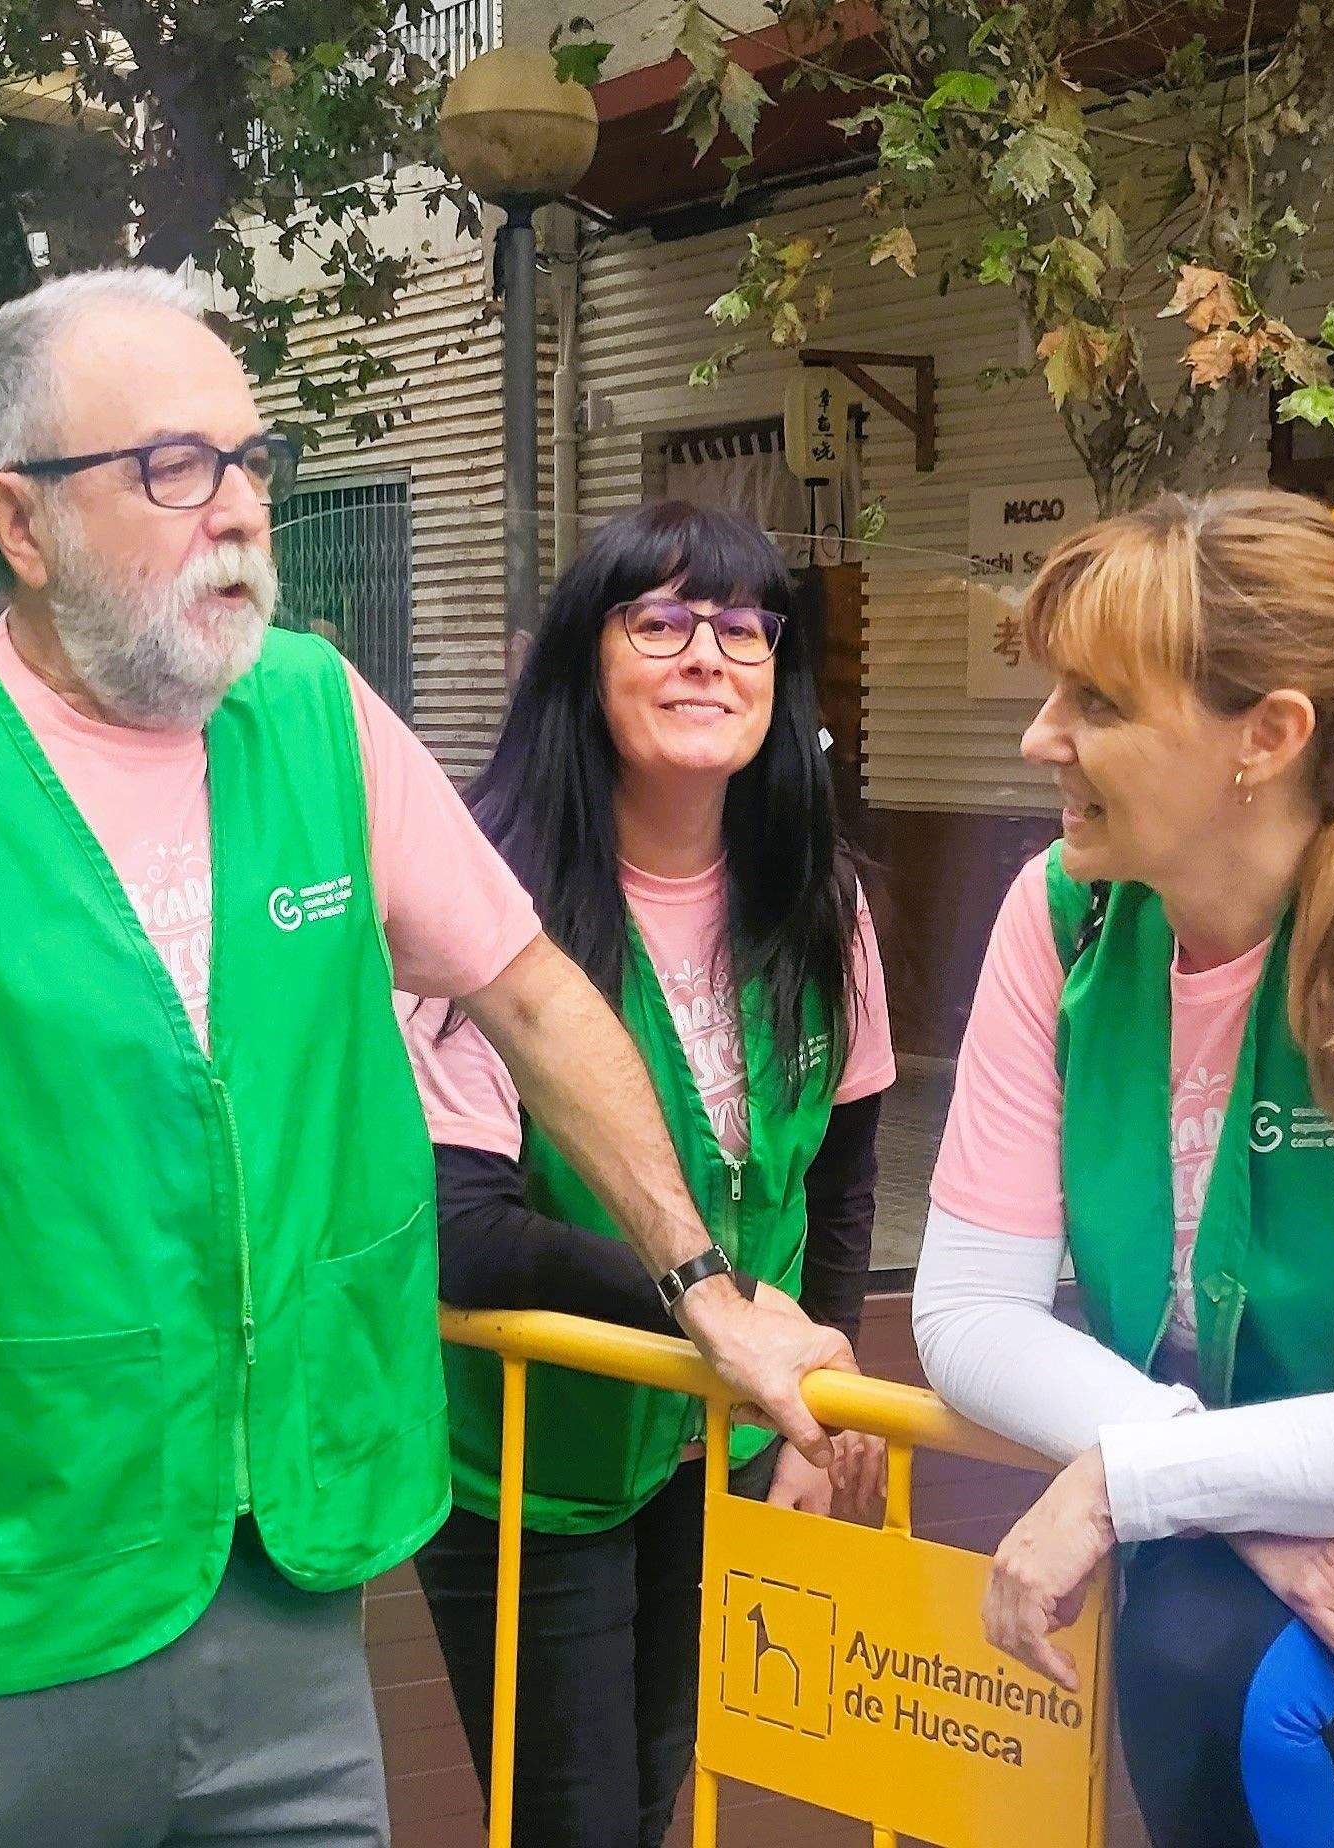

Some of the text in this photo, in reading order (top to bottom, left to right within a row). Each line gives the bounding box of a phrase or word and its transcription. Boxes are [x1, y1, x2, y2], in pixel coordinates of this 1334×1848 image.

[1004, 499, 1065, 524] MACAO
[970, 552, 1013, 576] Sushi
[845, 1630, 1083, 1729] Ayuntamiento
[844, 1682, 1023, 1768] de Huesca
